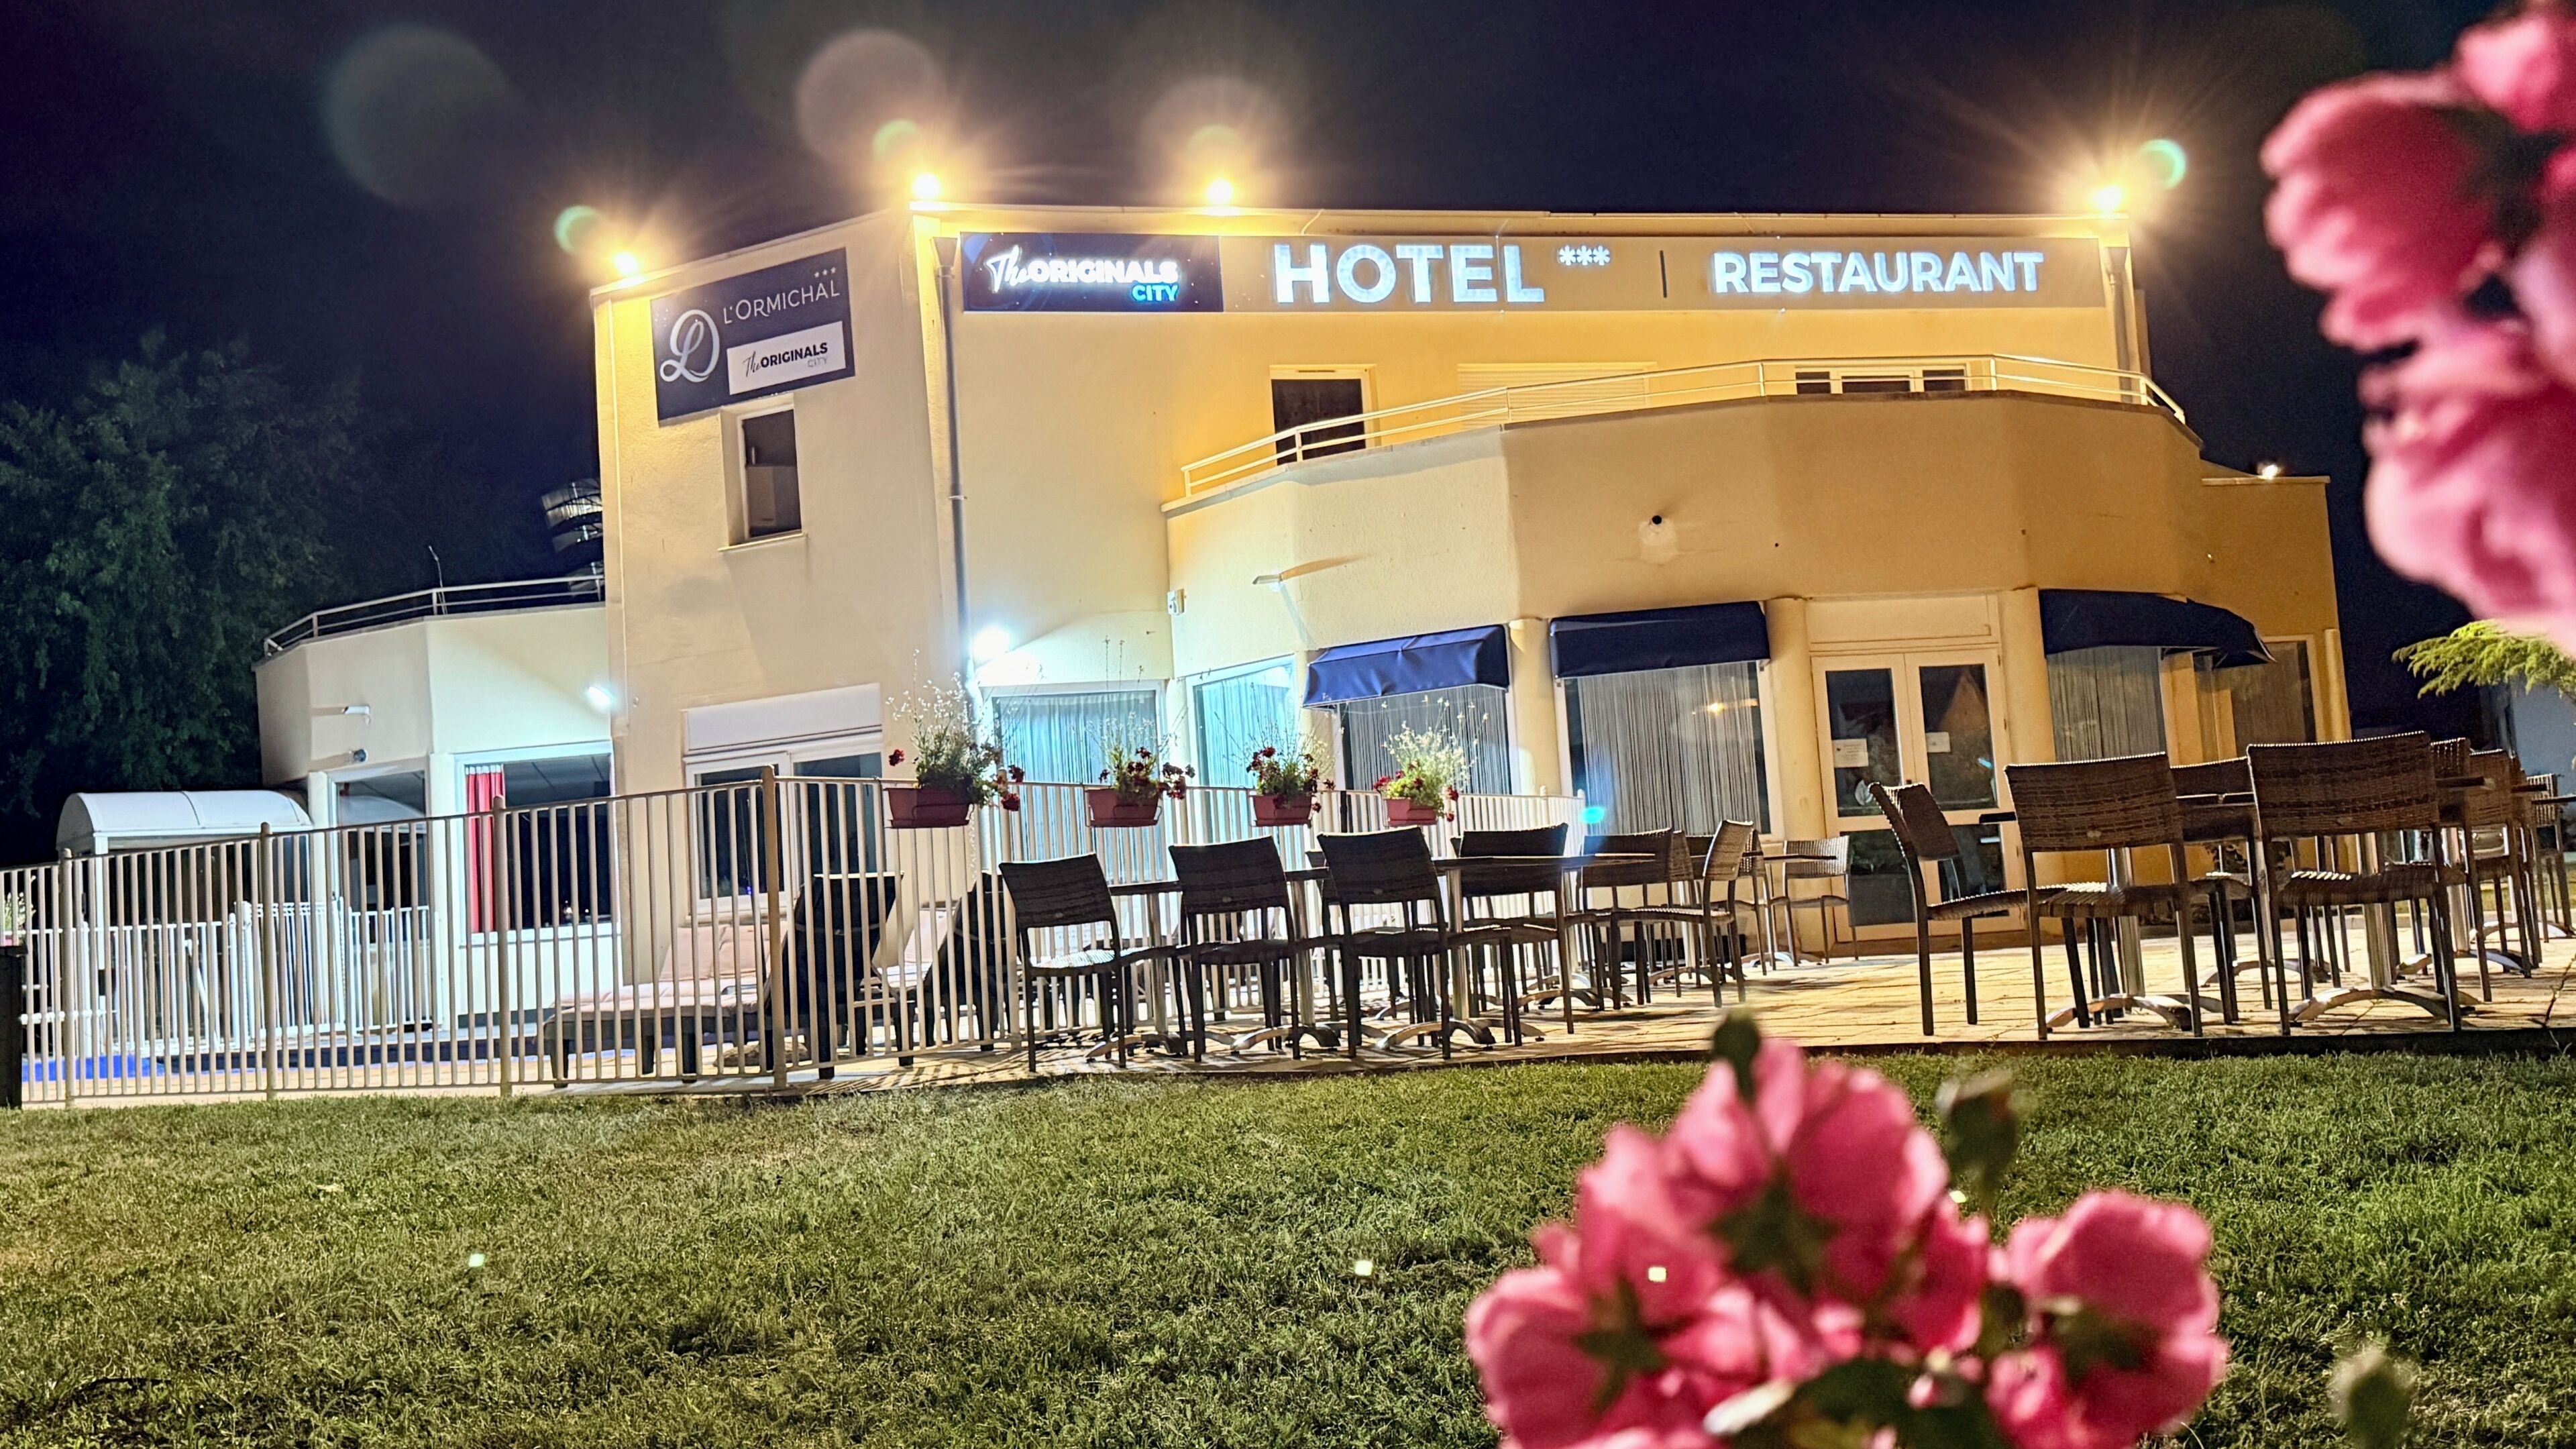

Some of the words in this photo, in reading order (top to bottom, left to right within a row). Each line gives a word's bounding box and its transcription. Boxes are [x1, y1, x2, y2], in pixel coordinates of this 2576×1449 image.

[1028, 260, 1179, 284] ORIGINALS
[1274, 244, 1545, 303] HOTEL
[1713, 252, 2044, 293] RESTAURANT
[723, 280, 841, 325] L'ORMICHAL
[1132, 284, 1179, 302] CITY
[760, 342, 828, 368] ORIGINALS
[807, 356, 828, 368] CITY
